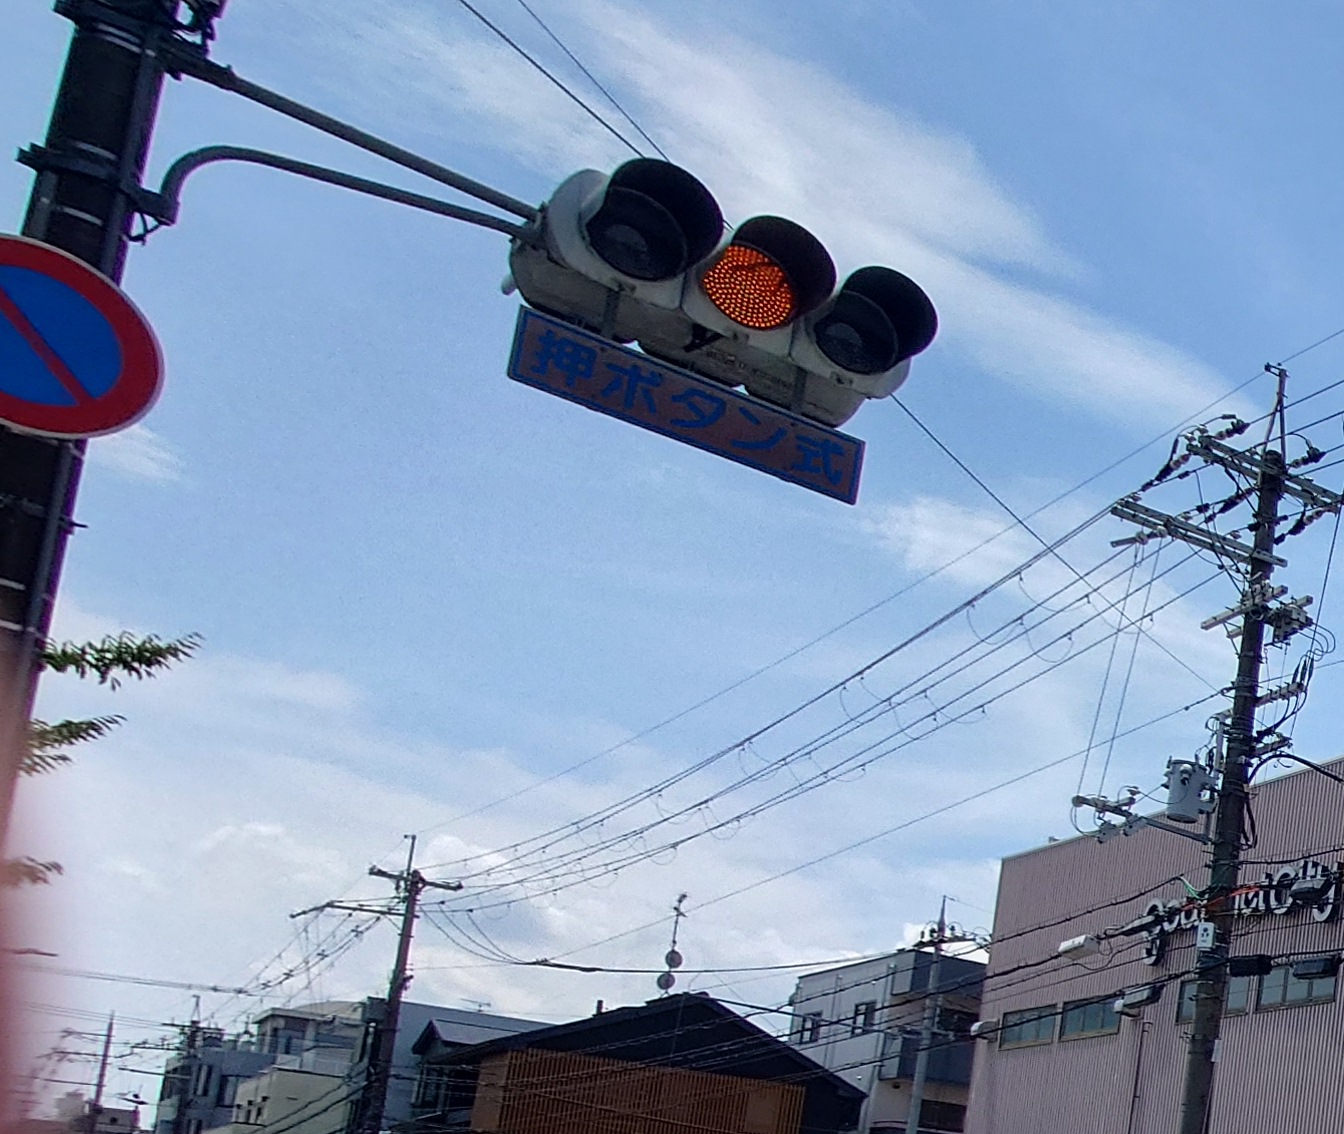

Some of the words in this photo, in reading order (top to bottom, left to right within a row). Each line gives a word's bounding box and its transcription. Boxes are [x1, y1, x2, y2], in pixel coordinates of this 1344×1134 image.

[530, 329, 845, 486] 押ボタン式
